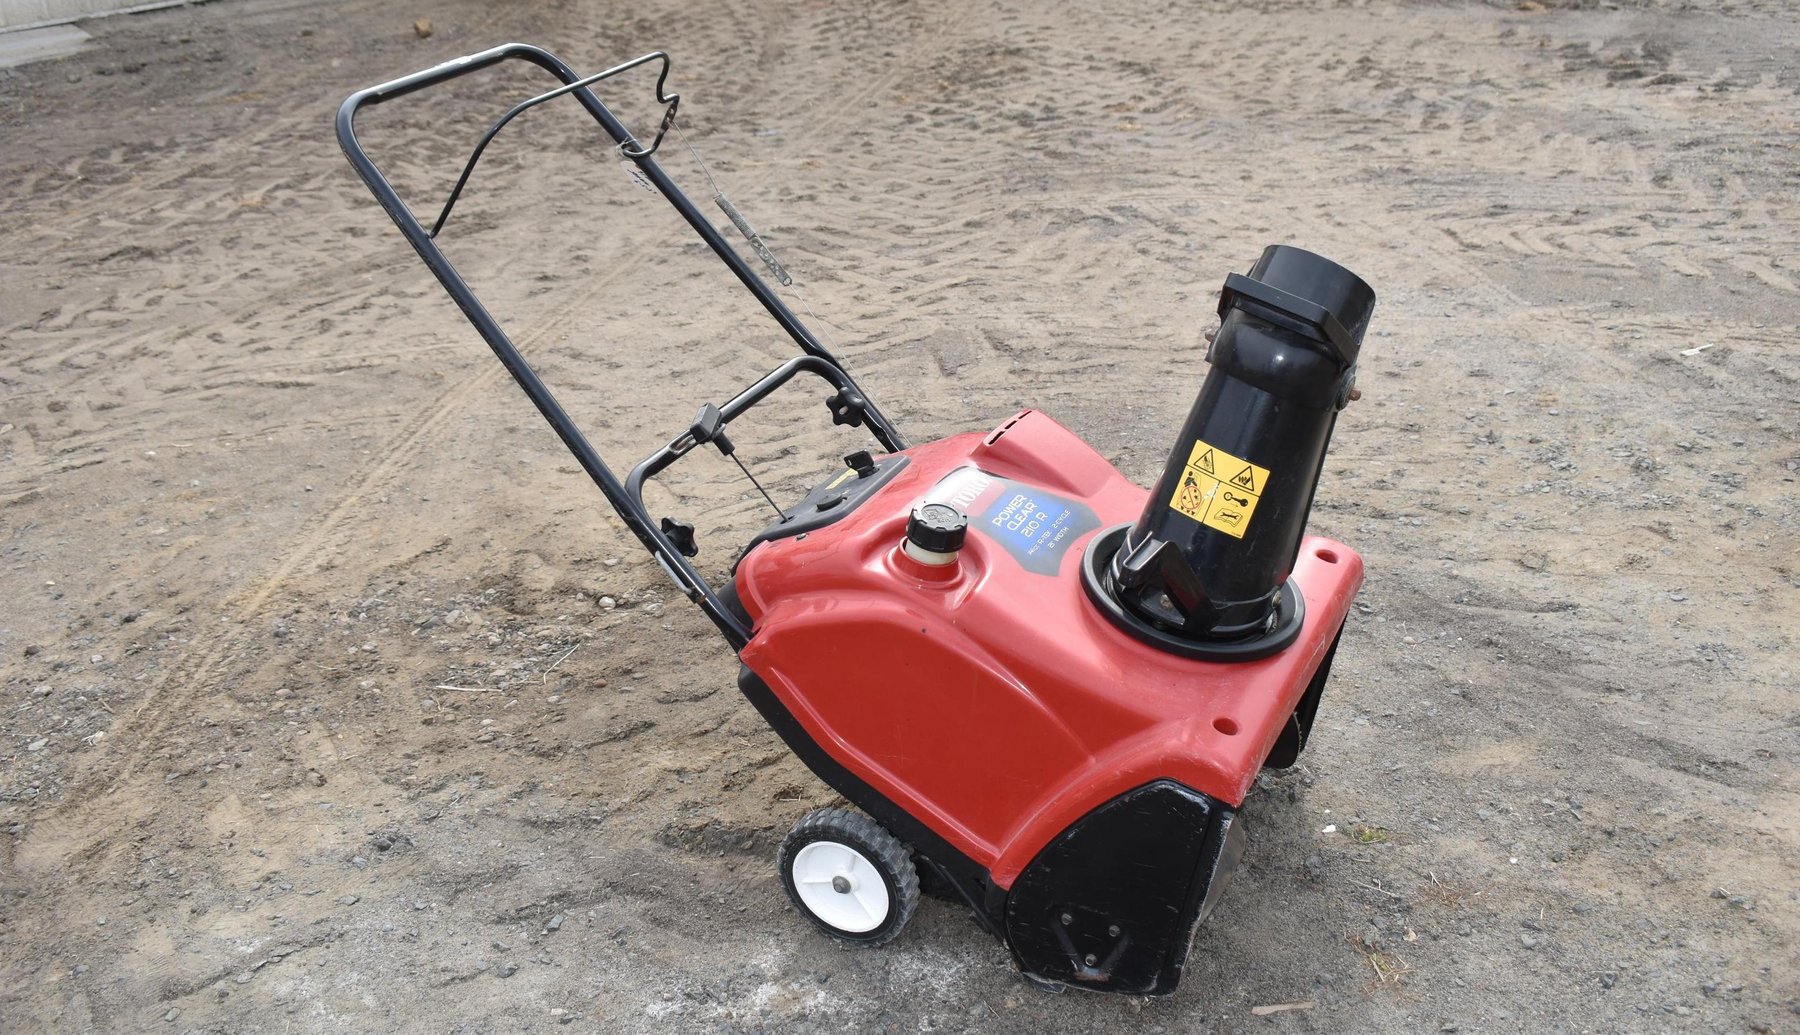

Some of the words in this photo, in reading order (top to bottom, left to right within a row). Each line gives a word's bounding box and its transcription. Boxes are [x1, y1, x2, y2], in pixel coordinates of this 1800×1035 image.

[951, 478, 990, 508] TORO
[992, 494, 1028, 527] POWER
[1006, 501, 1038, 531] CLEAR
[1020, 520, 1040, 538] 210
[1035, 511, 1048, 522] R
